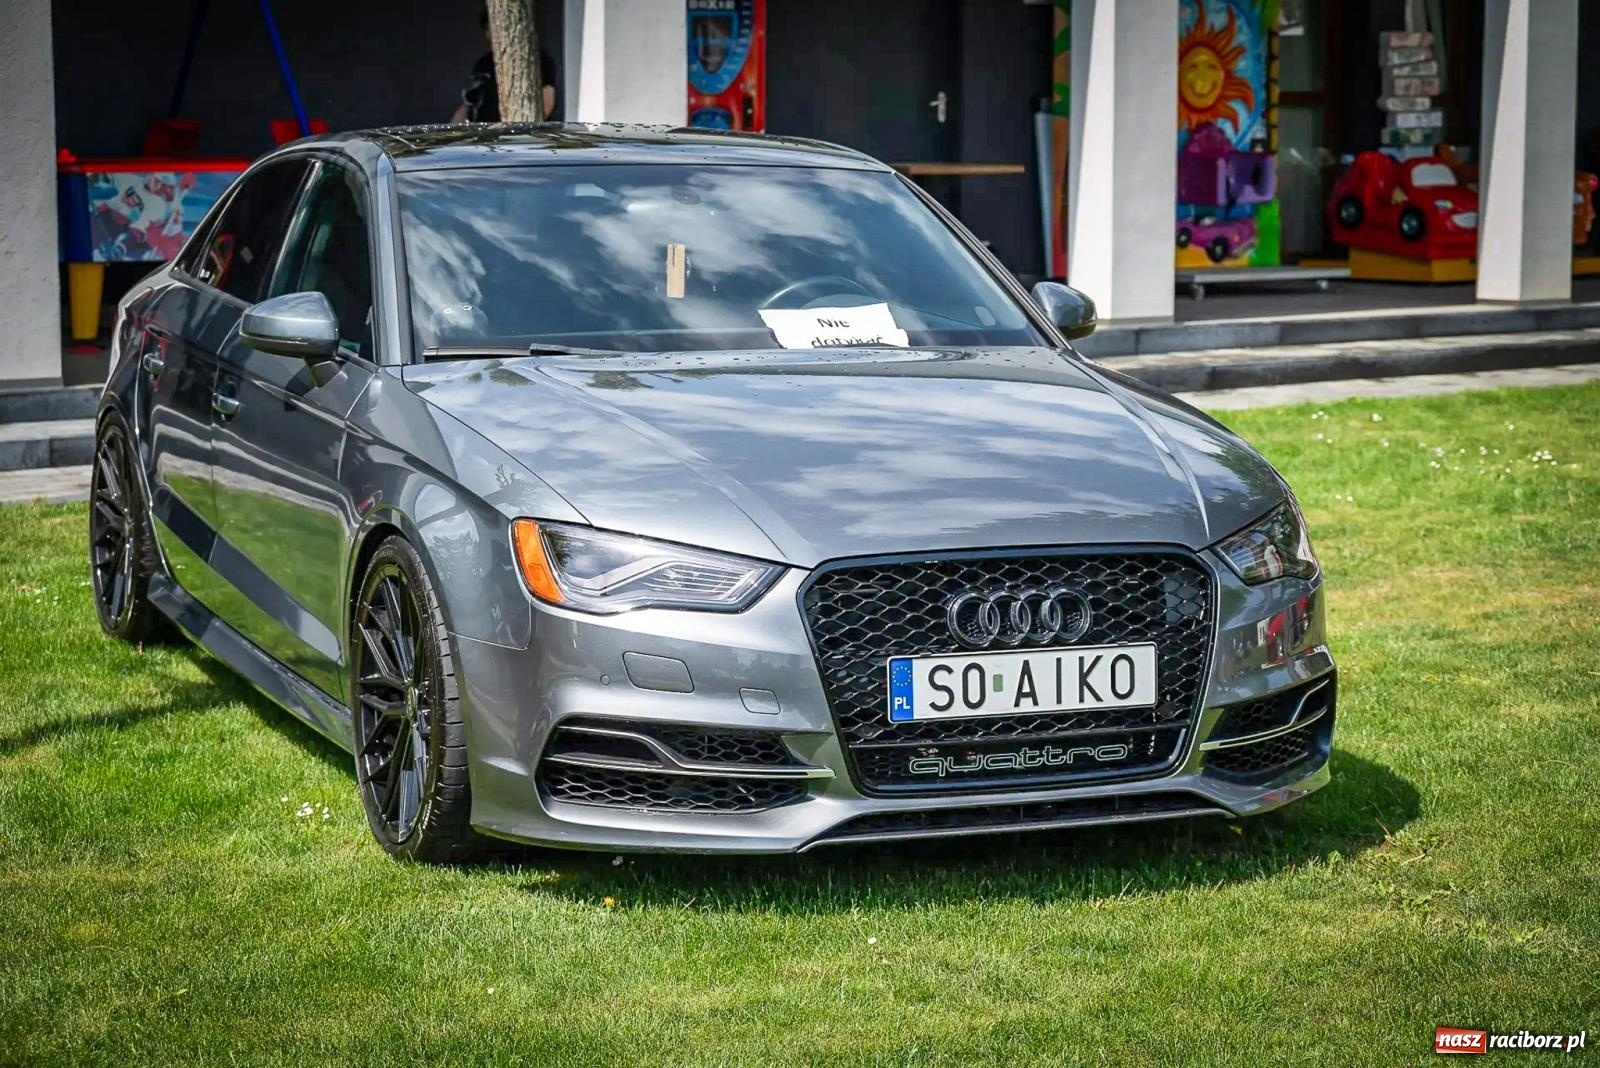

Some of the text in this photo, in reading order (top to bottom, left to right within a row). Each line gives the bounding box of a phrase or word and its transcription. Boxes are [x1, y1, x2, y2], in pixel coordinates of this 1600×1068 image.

[816, 318, 850, 328] Nie
[928, 653, 1135, 712] SO AIKO
[894, 696, 911, 710] PL
[909, 743, 1128, 777] quattro
